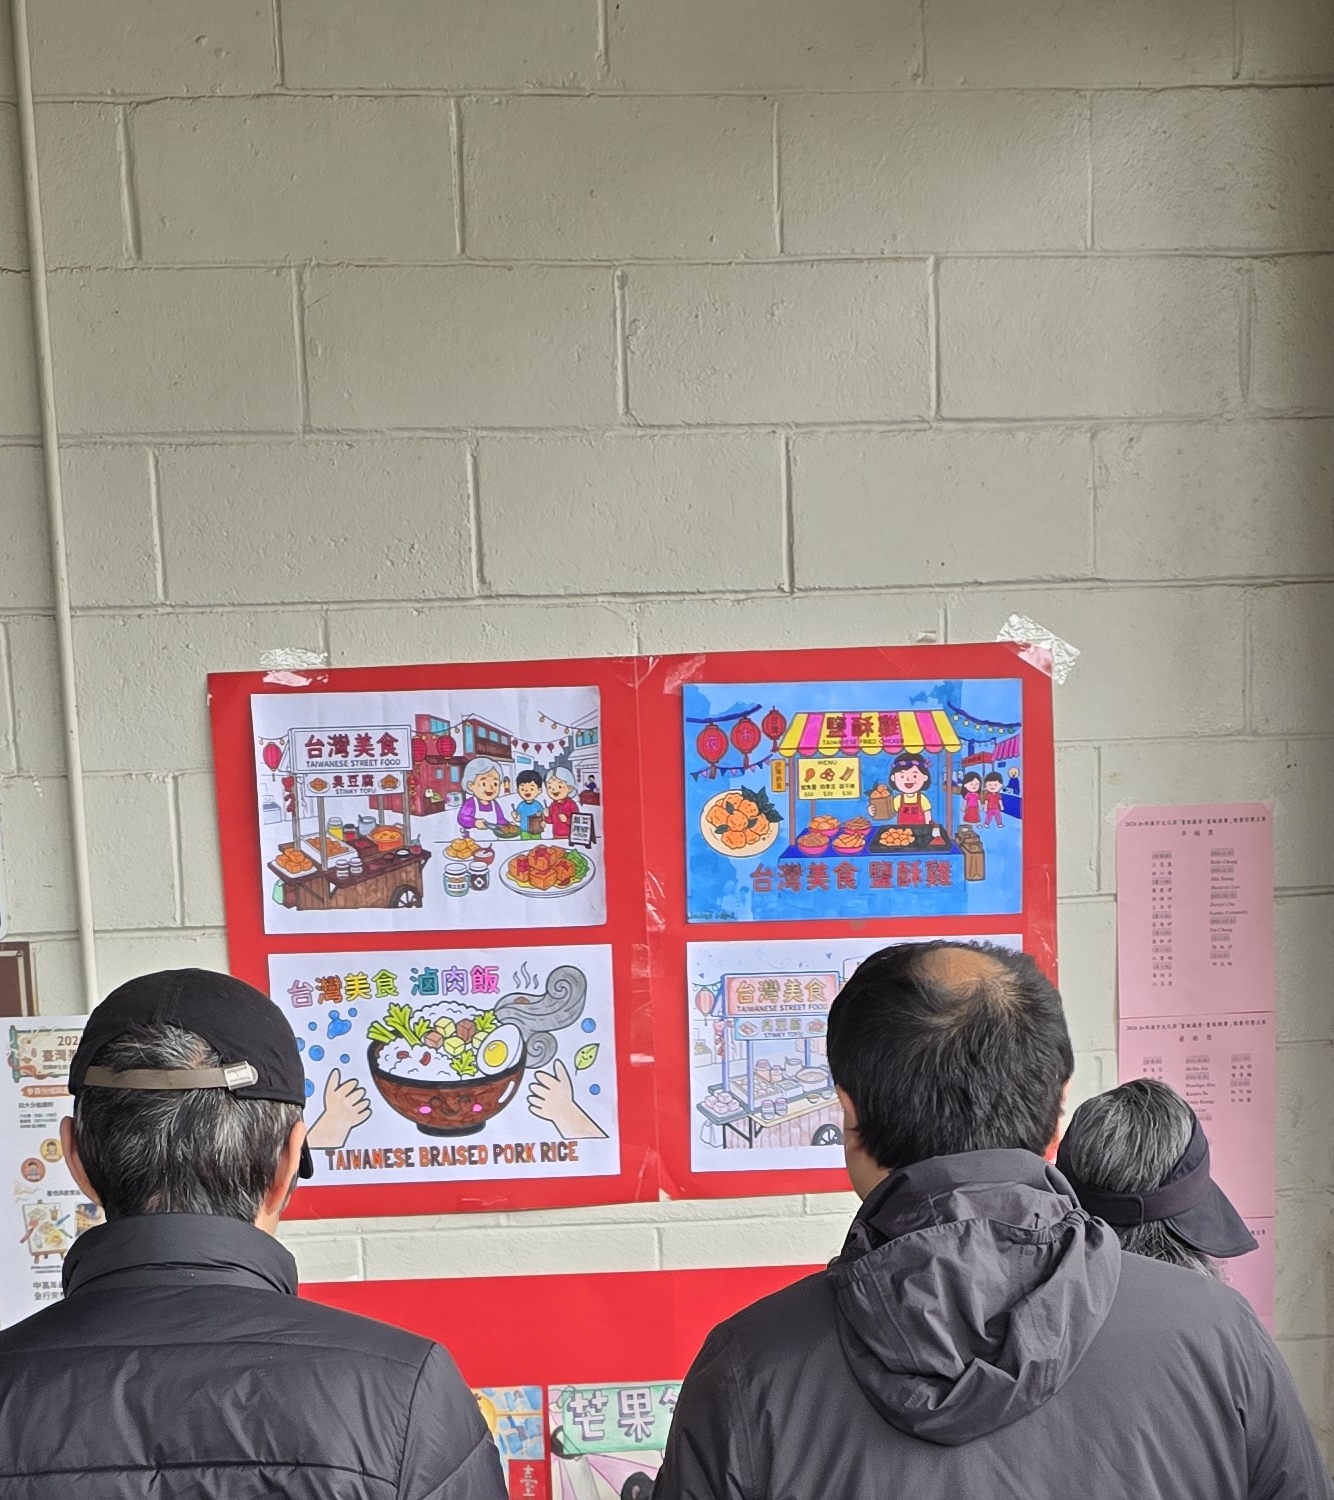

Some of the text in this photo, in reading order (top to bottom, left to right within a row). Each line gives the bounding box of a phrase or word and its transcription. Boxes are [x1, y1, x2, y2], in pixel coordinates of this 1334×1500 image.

[305, 732, 399, 759] 台灣美食
[306, 758, 401, 768] TAIWANESE STREET FOOD
[750, 860, 859, 893] 台灣美食
[287, 965, 500, 1008] 台灣美食 滷肉飯
[736, 977, 827, 1005] 台灣美食
[780, 1004, 806, 1012] STREET
[57, 1036, 80, 1046] 202
[325, 1141, 579, 1171] TAIWANESE BRAISED PORK RICE
